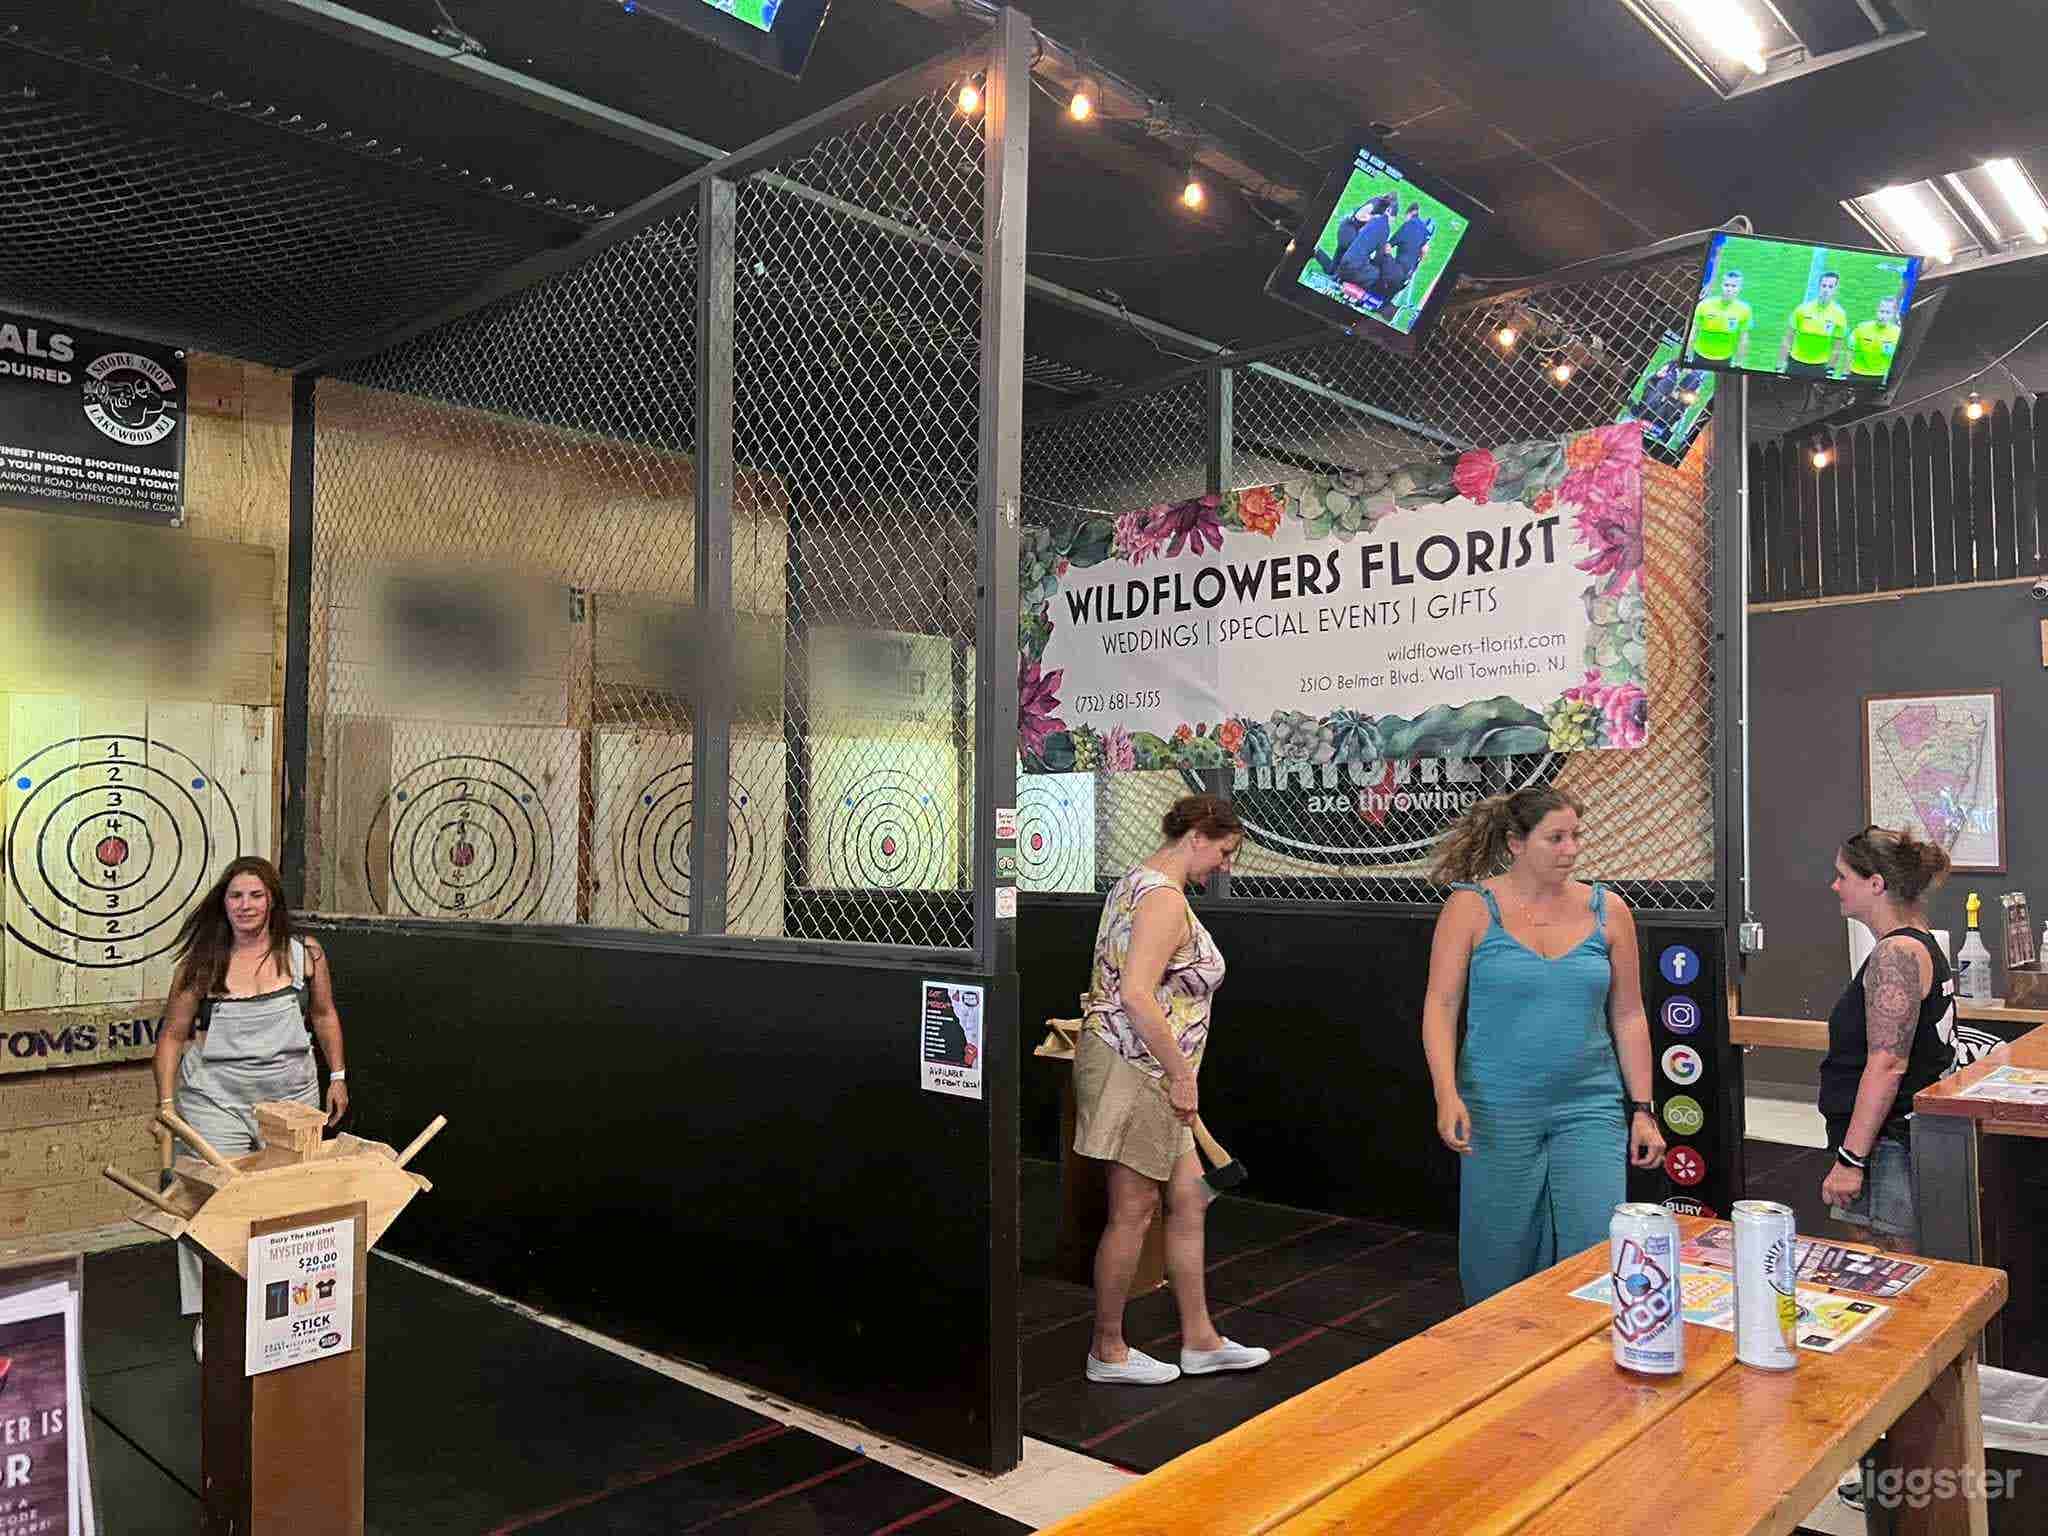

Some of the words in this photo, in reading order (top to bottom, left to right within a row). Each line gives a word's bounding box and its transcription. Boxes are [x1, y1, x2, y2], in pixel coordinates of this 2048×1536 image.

[8, 459, 41, 472] YOUR
[44, 463, 85, 478] PISTOL
[87, 470, 104, 481] OR
[106, 473, 137, 485] RIFLE
[37, 451, 82, 465] INDOOR
[85, 458, 140, 474] SHOOTING
[143, 467, 179, 480] RANGE
[0, 471, 41, 484] AIRPORT
[44, 476, 73, 488] ROAD
[151, 491, 176, 502] 08701
[1065, 549, 1341, 625] WILDFLOWERS
[1361, 516, 1560, 589] FLORIST
[1103, 623, 1198, 654] WEDDINGS
[1219, 612, 1308, 642] SPECIAL
[1319, 600, 1400, 632] EVENTS
[1427, 587, 1497, 620] GIFTS
[1387, 634, 1566, 661] wildflowers-florist.com
[1300, 676, 1331, 693] 2510
[1338, 674, 1384, 690] Belmar
[1429, 664, 1463, 680] Wall
[1548, 656, 1566, 671] NJ
[1109, 690, 1161, 712] 681-5155
[107, 742, 126, 758] 1
[107, 768, 123, 781] 2
[107, 792, 122, 807] 3
[1307, 794, 1350, 813] axe
[1360, 786, 1477, 815] throwing
[107, 818, 122, 833] 4
[104, 871, 118, 882] 4
[105, 895, 119, 909] 3
[105, 920, 122, 933] 2
[104, 945, 122, 960] 1
[1666, 1201, 1702, 1217] BURY
[271, 1239, 315, 1261] MYSTERY
[317, 1236, 336, 1251] BOX
[298, 1251, 337, 1269] $20.00
[292, 1314, 331, 1333] STICK
[0, 1416, 31, 1445] ER
[41, 1408, 63, 1436] IS
